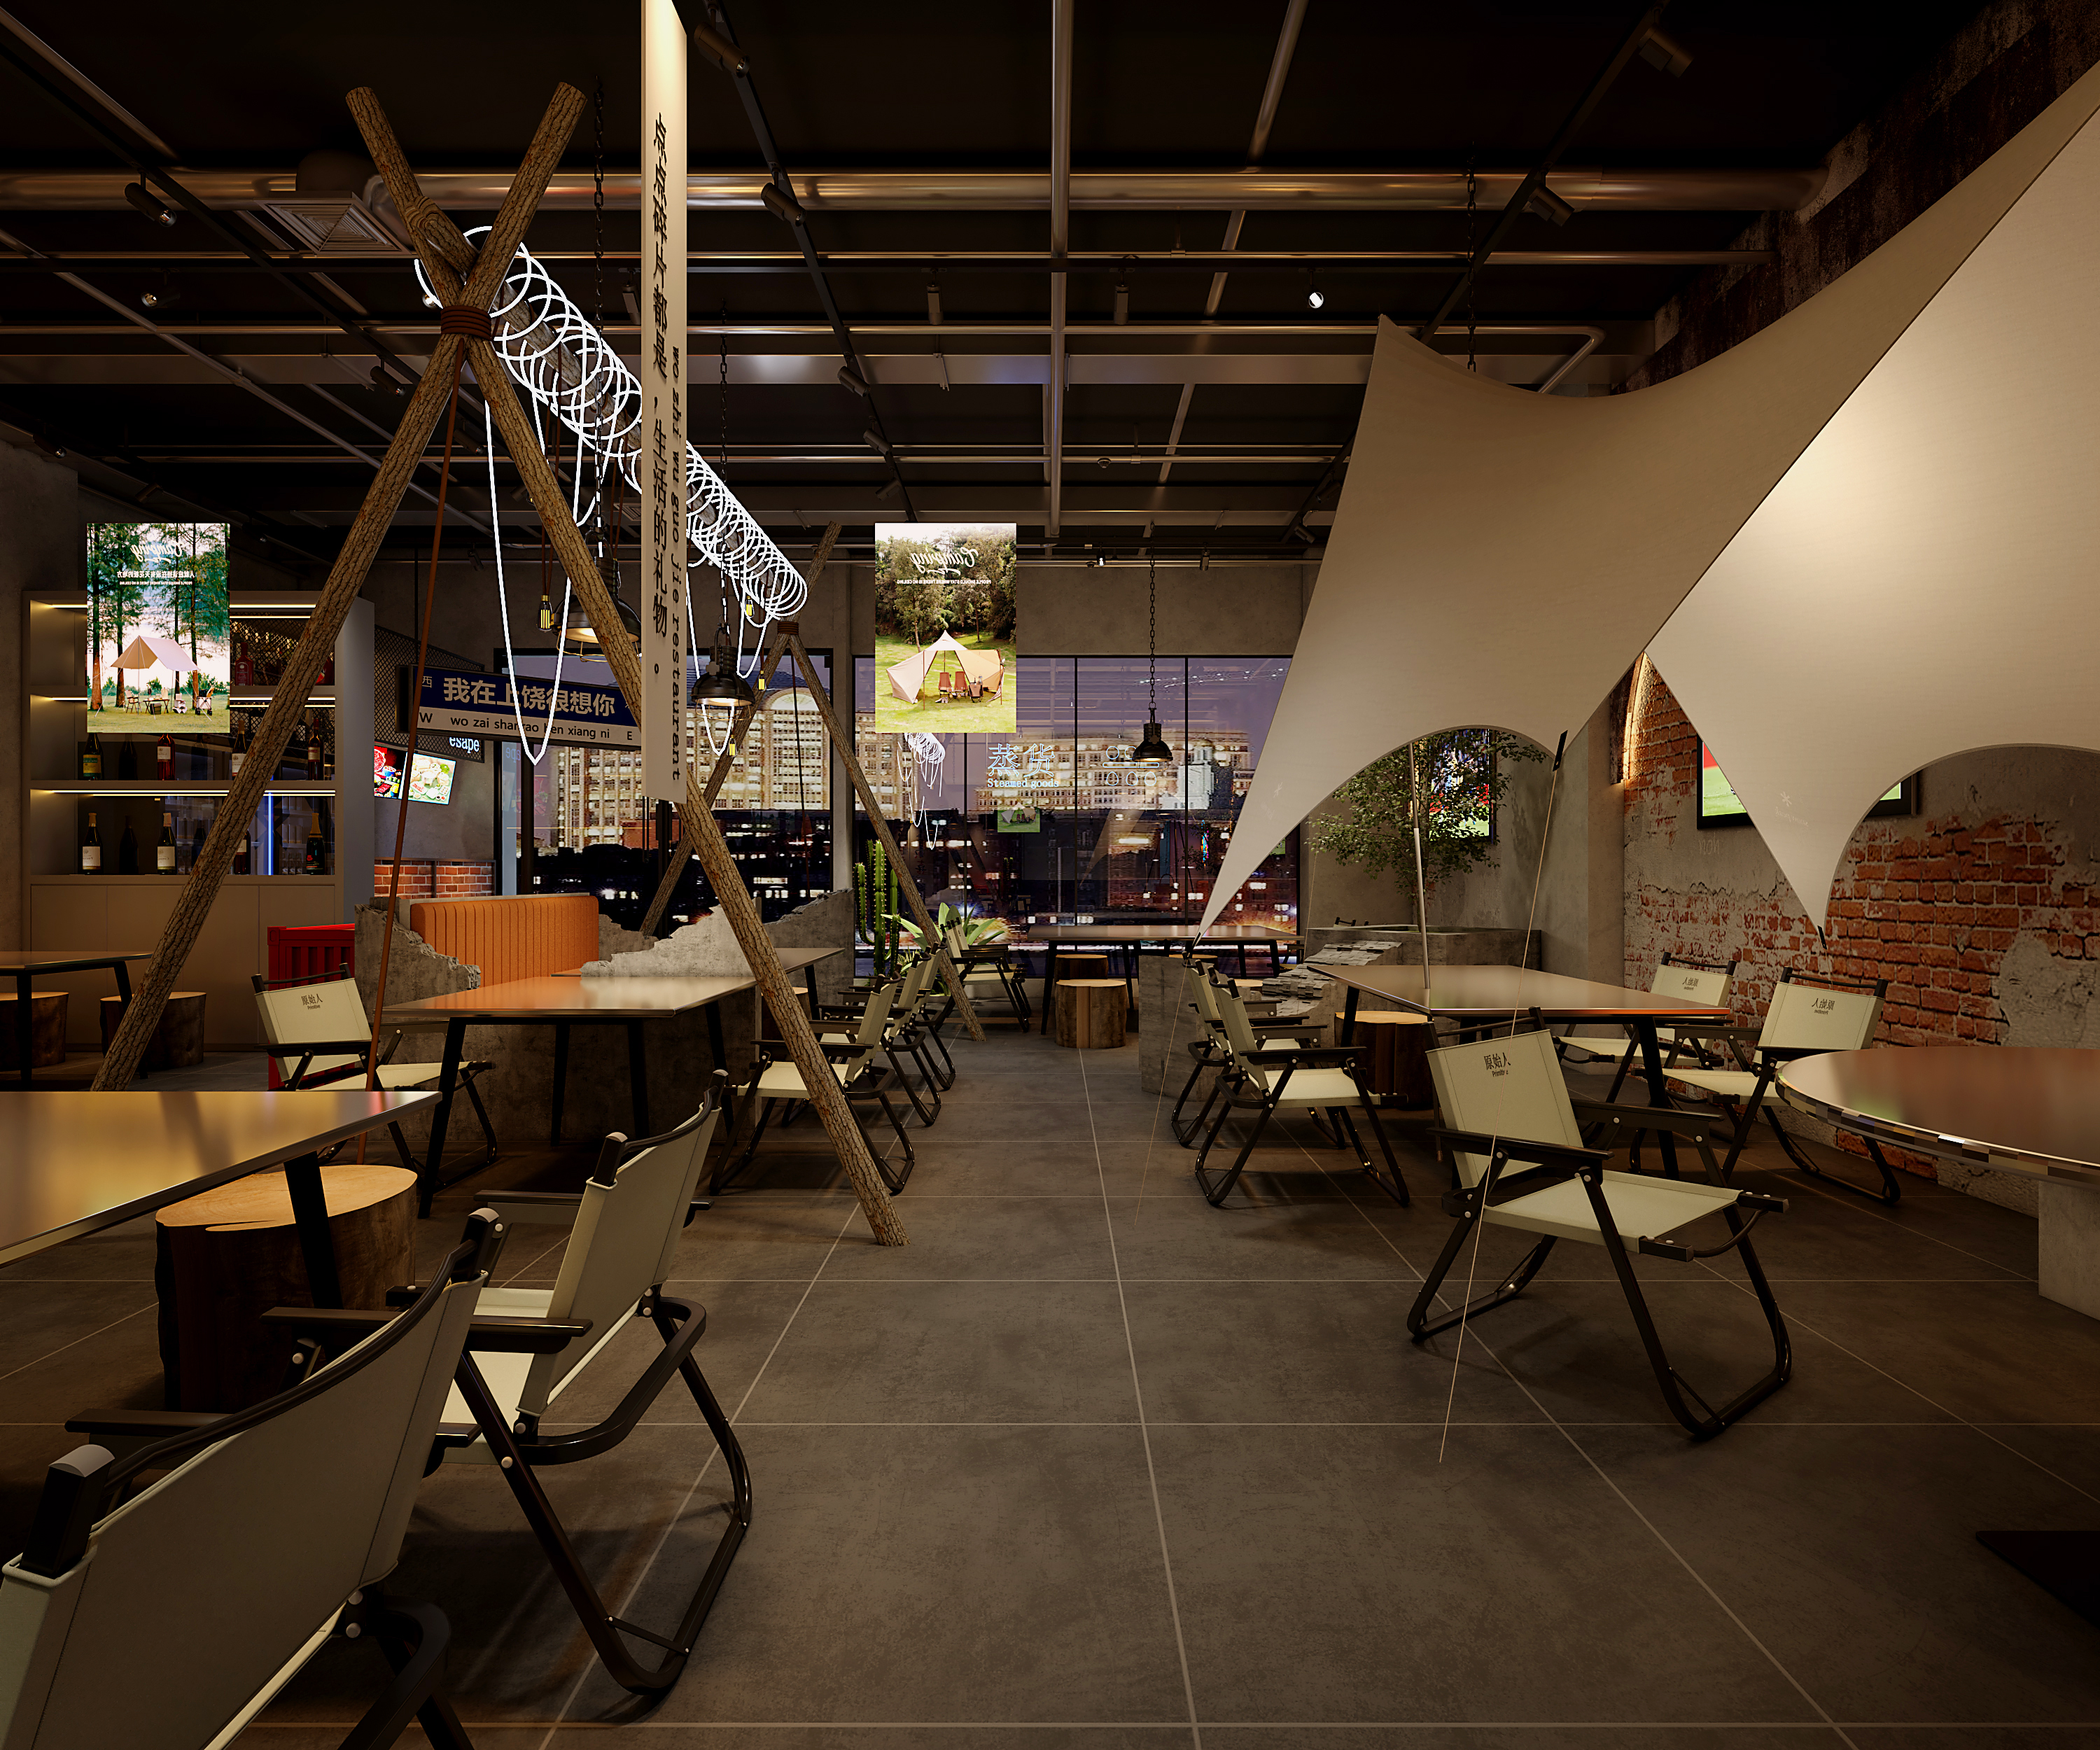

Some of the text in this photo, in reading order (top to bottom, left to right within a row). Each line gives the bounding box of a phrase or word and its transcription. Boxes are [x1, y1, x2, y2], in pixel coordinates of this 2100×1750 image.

[671, 346, 682, 781] wo zhi wu guo jie restaurant
[421, 676, 615, 717] 西 我在上饶很想你
[419, 712, 433, 723] W
[450, 717, 468, 727] wo
[473, 718, 489, 728] zai
[568, 725, 596, 740] xiang
[601, 729, 610, 738] ni
[627, 731, 633, 741] E
[987, 743, 1056, 778] 蒸货
[987, 778, 1059, 789] Steamed goods
[301, 993, 323, 1006] 原始人
[1483, 1052, 1511, 1071] 原始人
